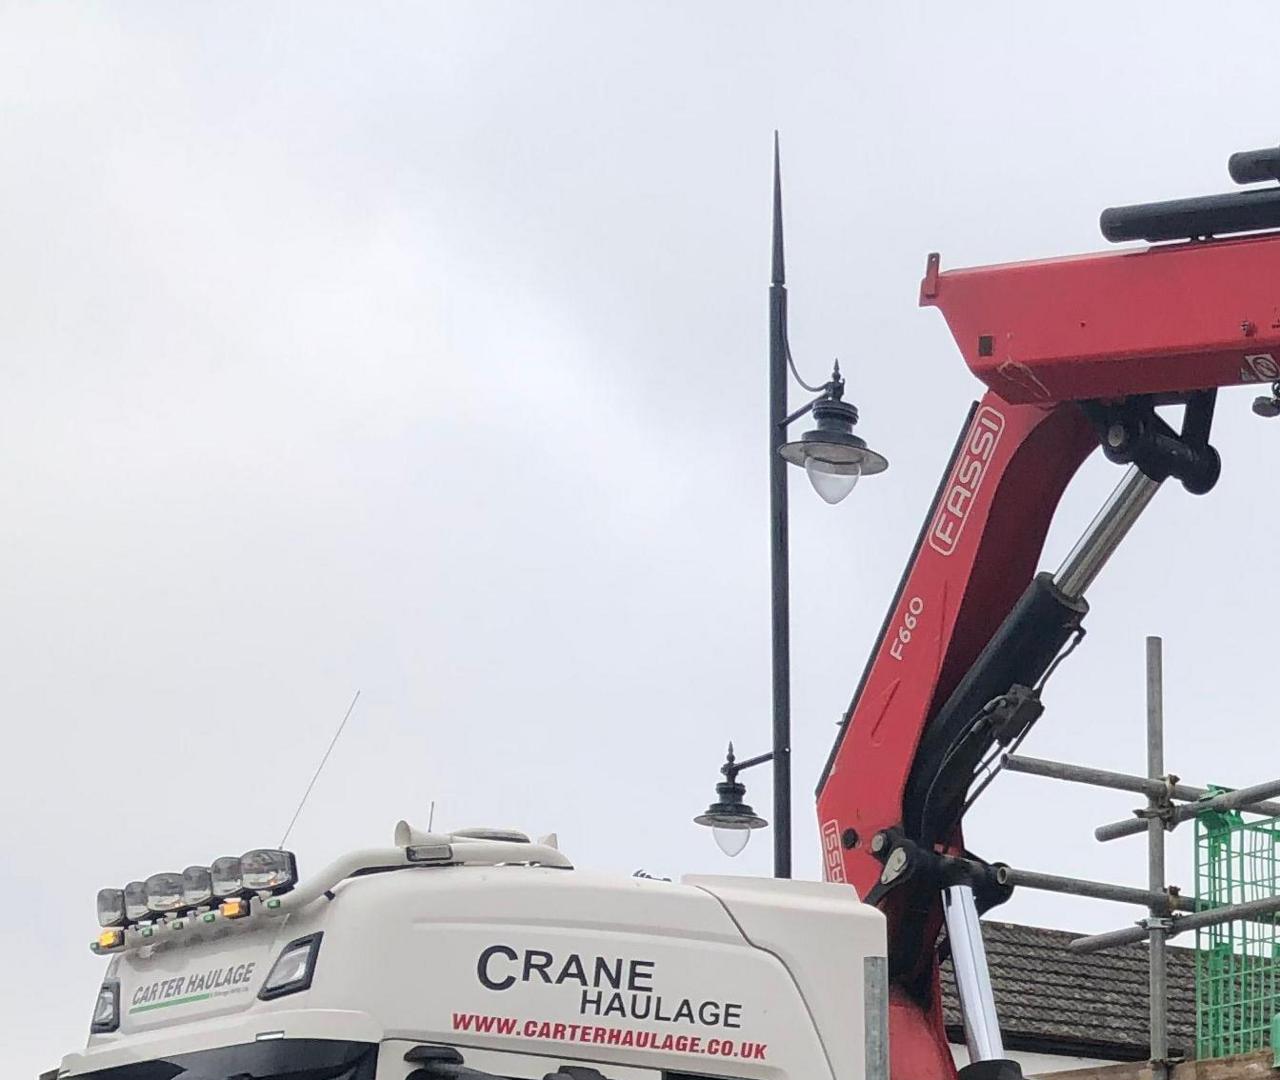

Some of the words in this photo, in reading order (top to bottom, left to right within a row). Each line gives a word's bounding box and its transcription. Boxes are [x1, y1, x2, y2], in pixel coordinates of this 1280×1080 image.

[935, 416, 1000, 546] FASSI
[890, 596, 924, 661] F660
[132, 976, 185, 1005] CARTER
[185, 962, 256, 993] HAULAGE
[476, 945, 656, 992] CRANE
[580, 989, 742, 1028] HAULAGE
[452, 1012, 767, 1060] WWW.CARTERHAULAGE.CO.UK
